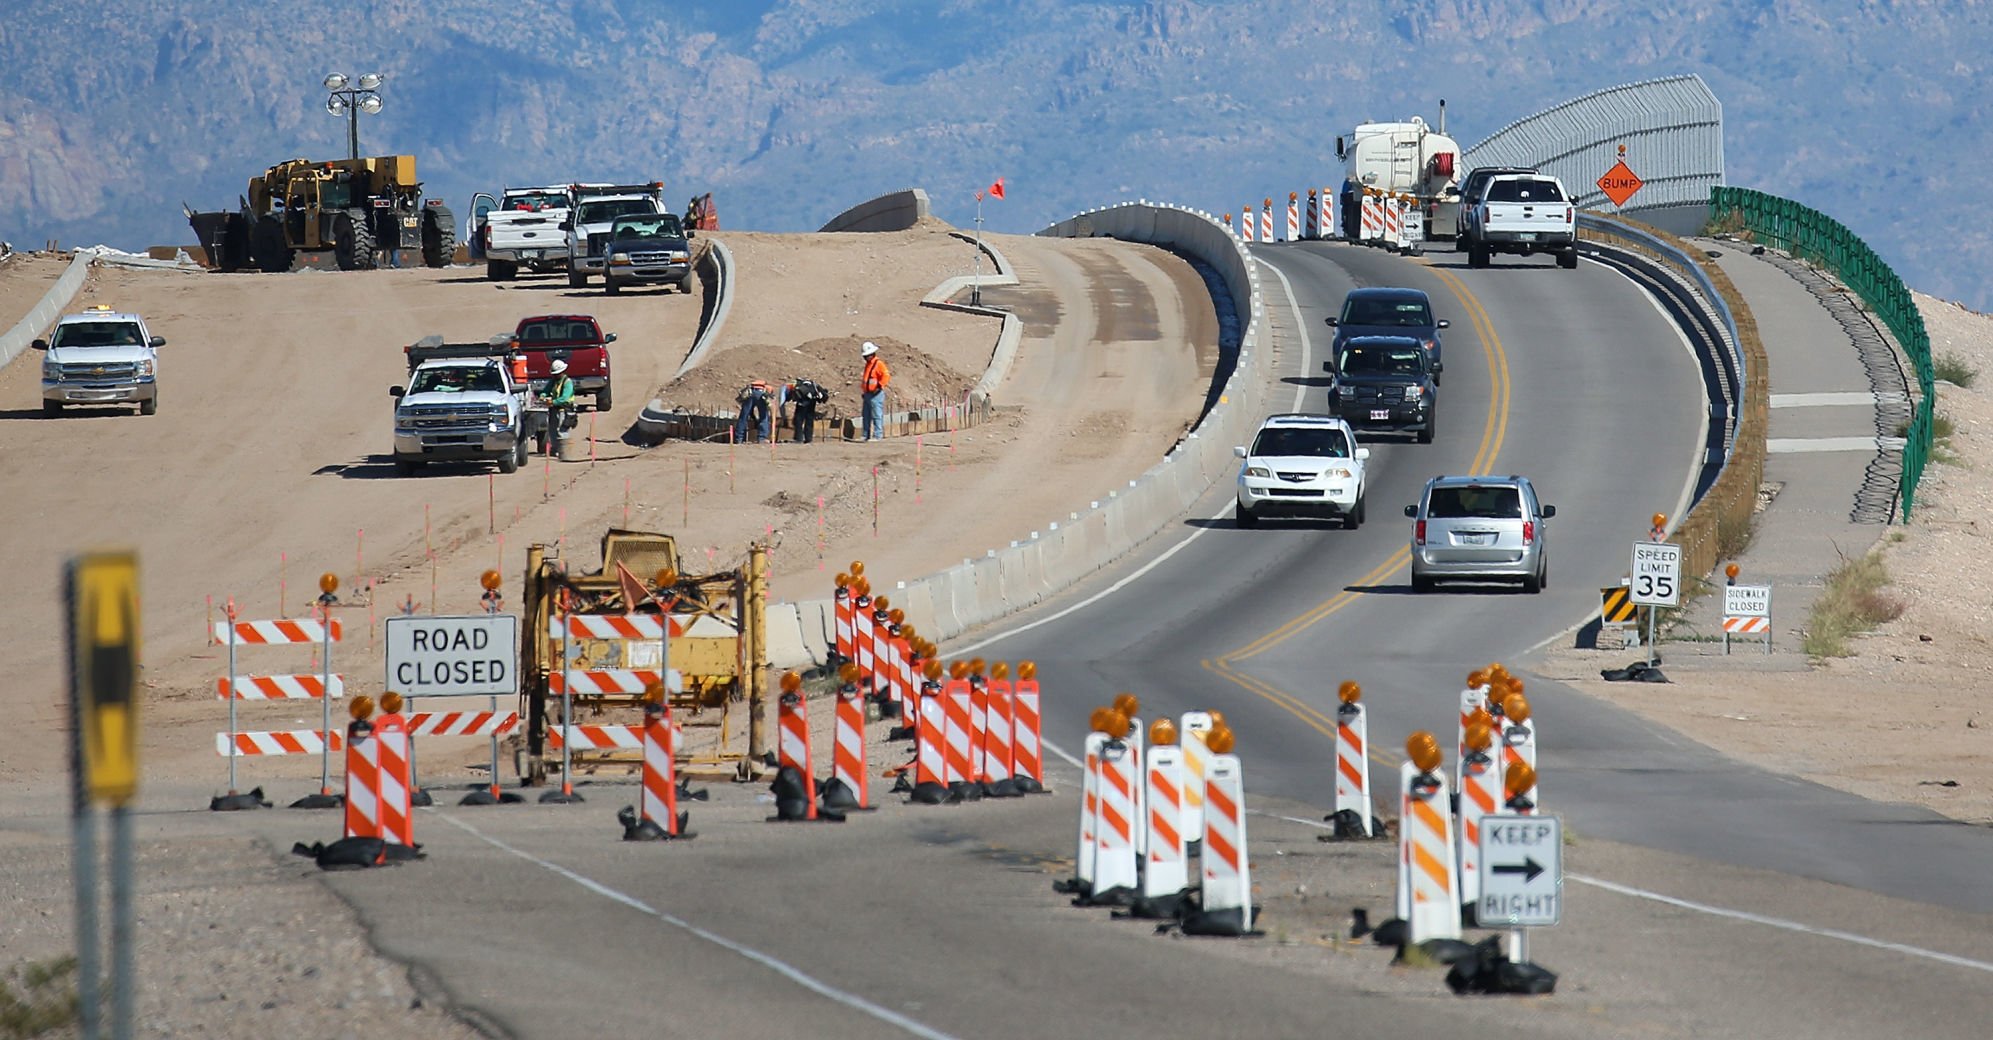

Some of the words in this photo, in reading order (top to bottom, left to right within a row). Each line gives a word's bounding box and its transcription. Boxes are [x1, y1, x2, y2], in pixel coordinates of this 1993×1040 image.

[1603, 178, 1637, 189] BUMP
[403, 217, 418, 227] CAT
[1637, 550, 1677, 561] SPEED
[1641, 563, 1671, 573] LIMIT
[1637, 575, 1672, 598] 35
[1728, 589, 1767, 598] SIDEWALK
[1729, 602, 1765, 611] CLOSED
[413, 628, 488, 652] ROAD
[397, 660, 505, 685] CLOSED
[1490, 825, 1551, 845] KEEP
[1486, 894, 1554, 916] RIGHT
